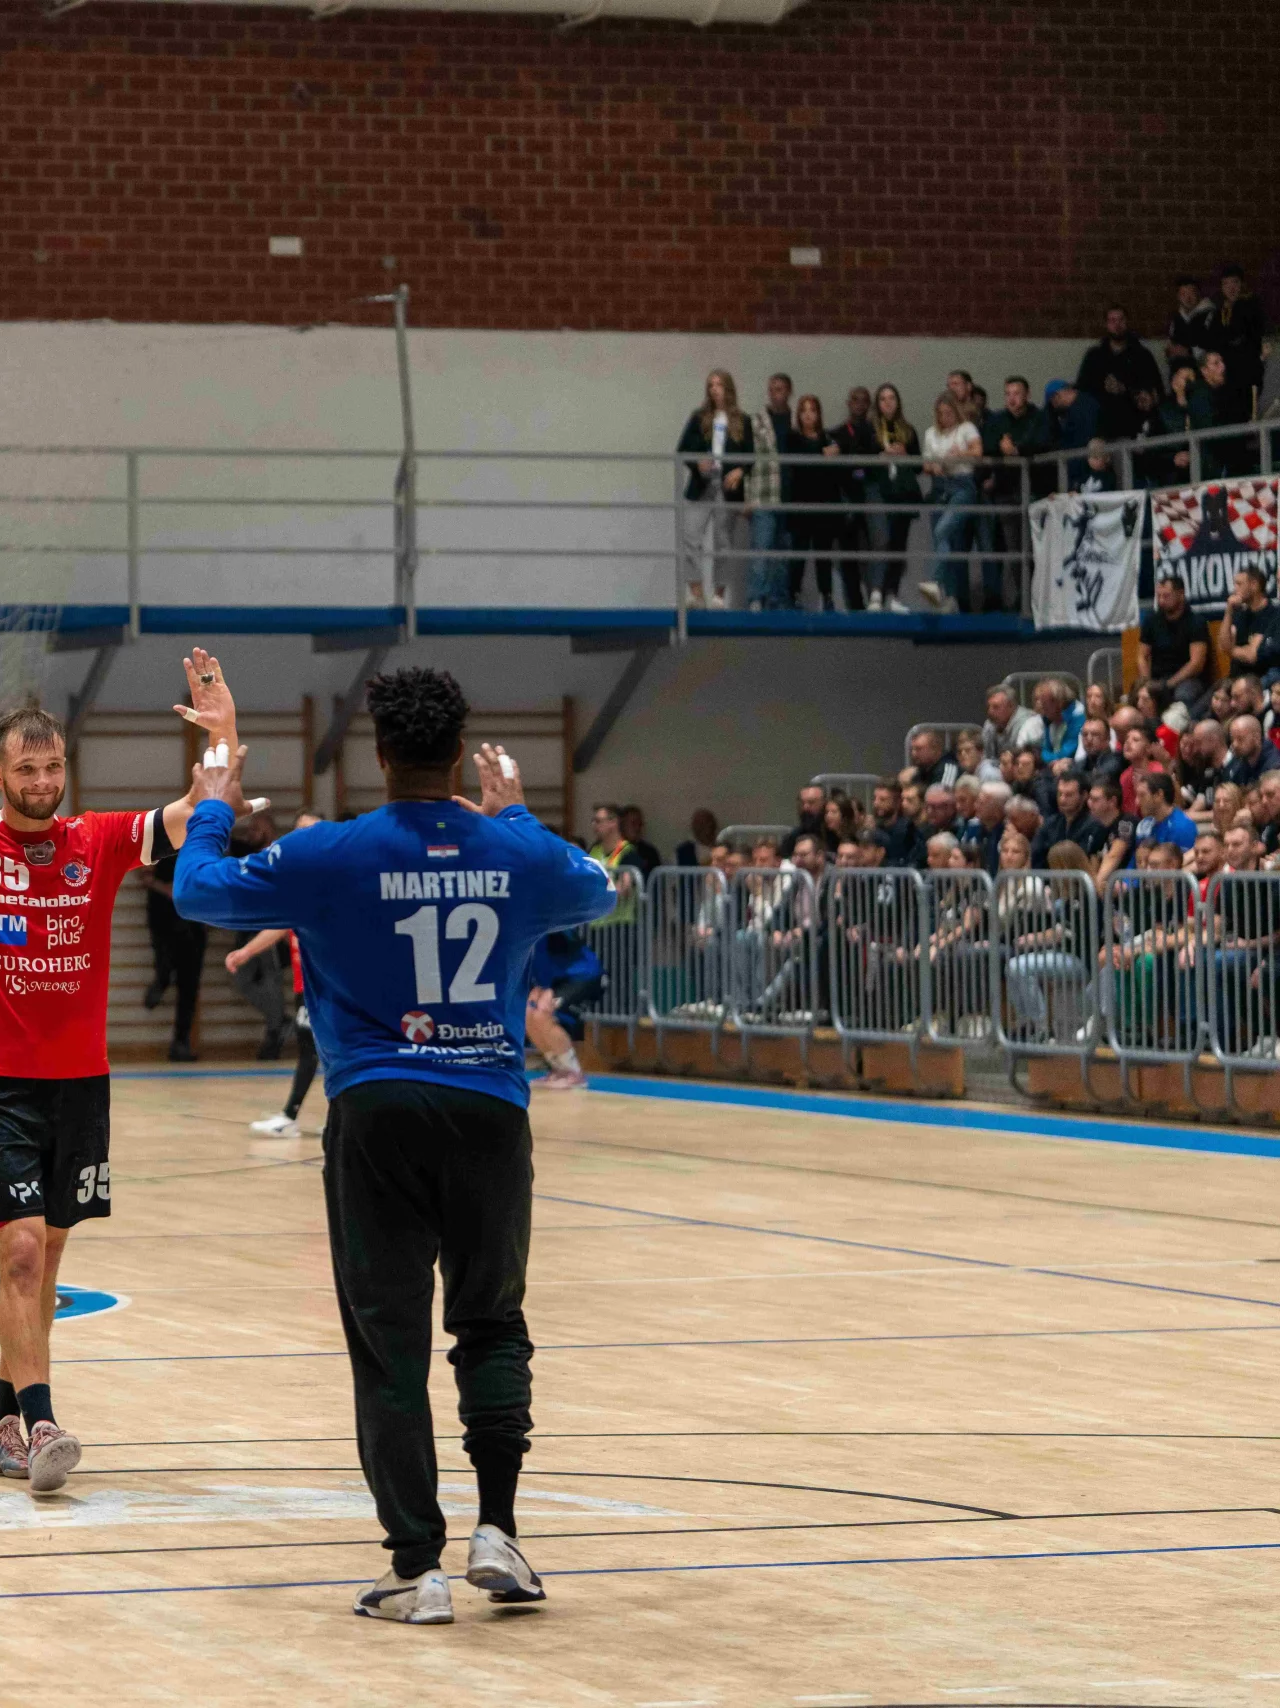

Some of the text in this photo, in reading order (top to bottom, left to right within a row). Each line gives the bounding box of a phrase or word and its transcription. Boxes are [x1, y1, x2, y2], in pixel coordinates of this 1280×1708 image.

[380, 871, 510, 900] MARTINEZ
[46, 915, 80, 931] biro
[47, 929, 81, 949] plus
[395, 903, 500, 1005] 12
[438, 1022, 505, 1040] Đurkin
[76, 1162, 111, 1204] 35
